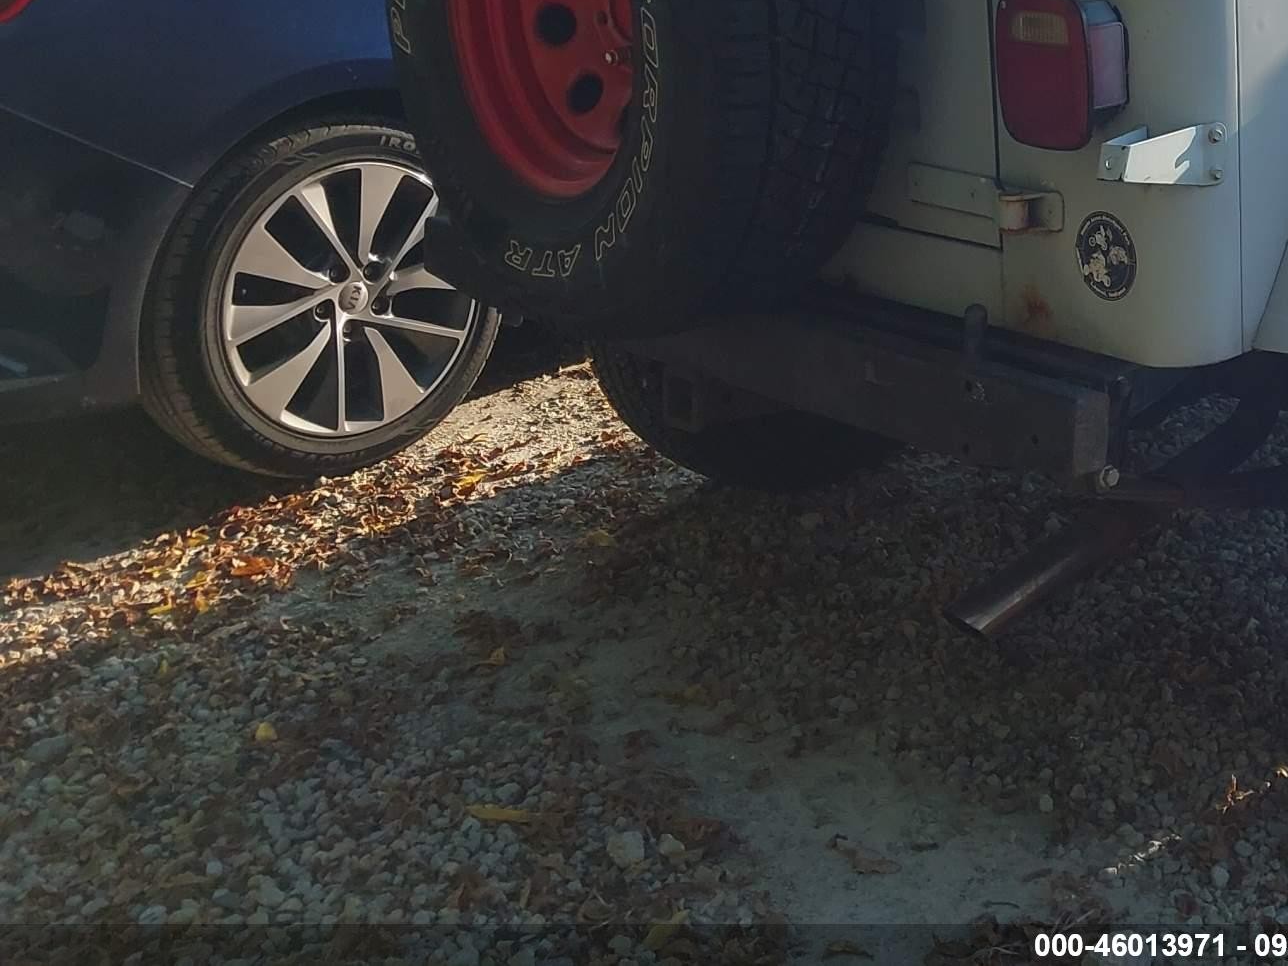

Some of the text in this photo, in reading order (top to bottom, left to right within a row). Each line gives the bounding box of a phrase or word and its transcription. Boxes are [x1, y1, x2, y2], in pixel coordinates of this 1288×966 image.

[380, 135, 420, 153] IRO
[505, 240, 581, 277] ATR
[344, 285, 362, 310] KIA
